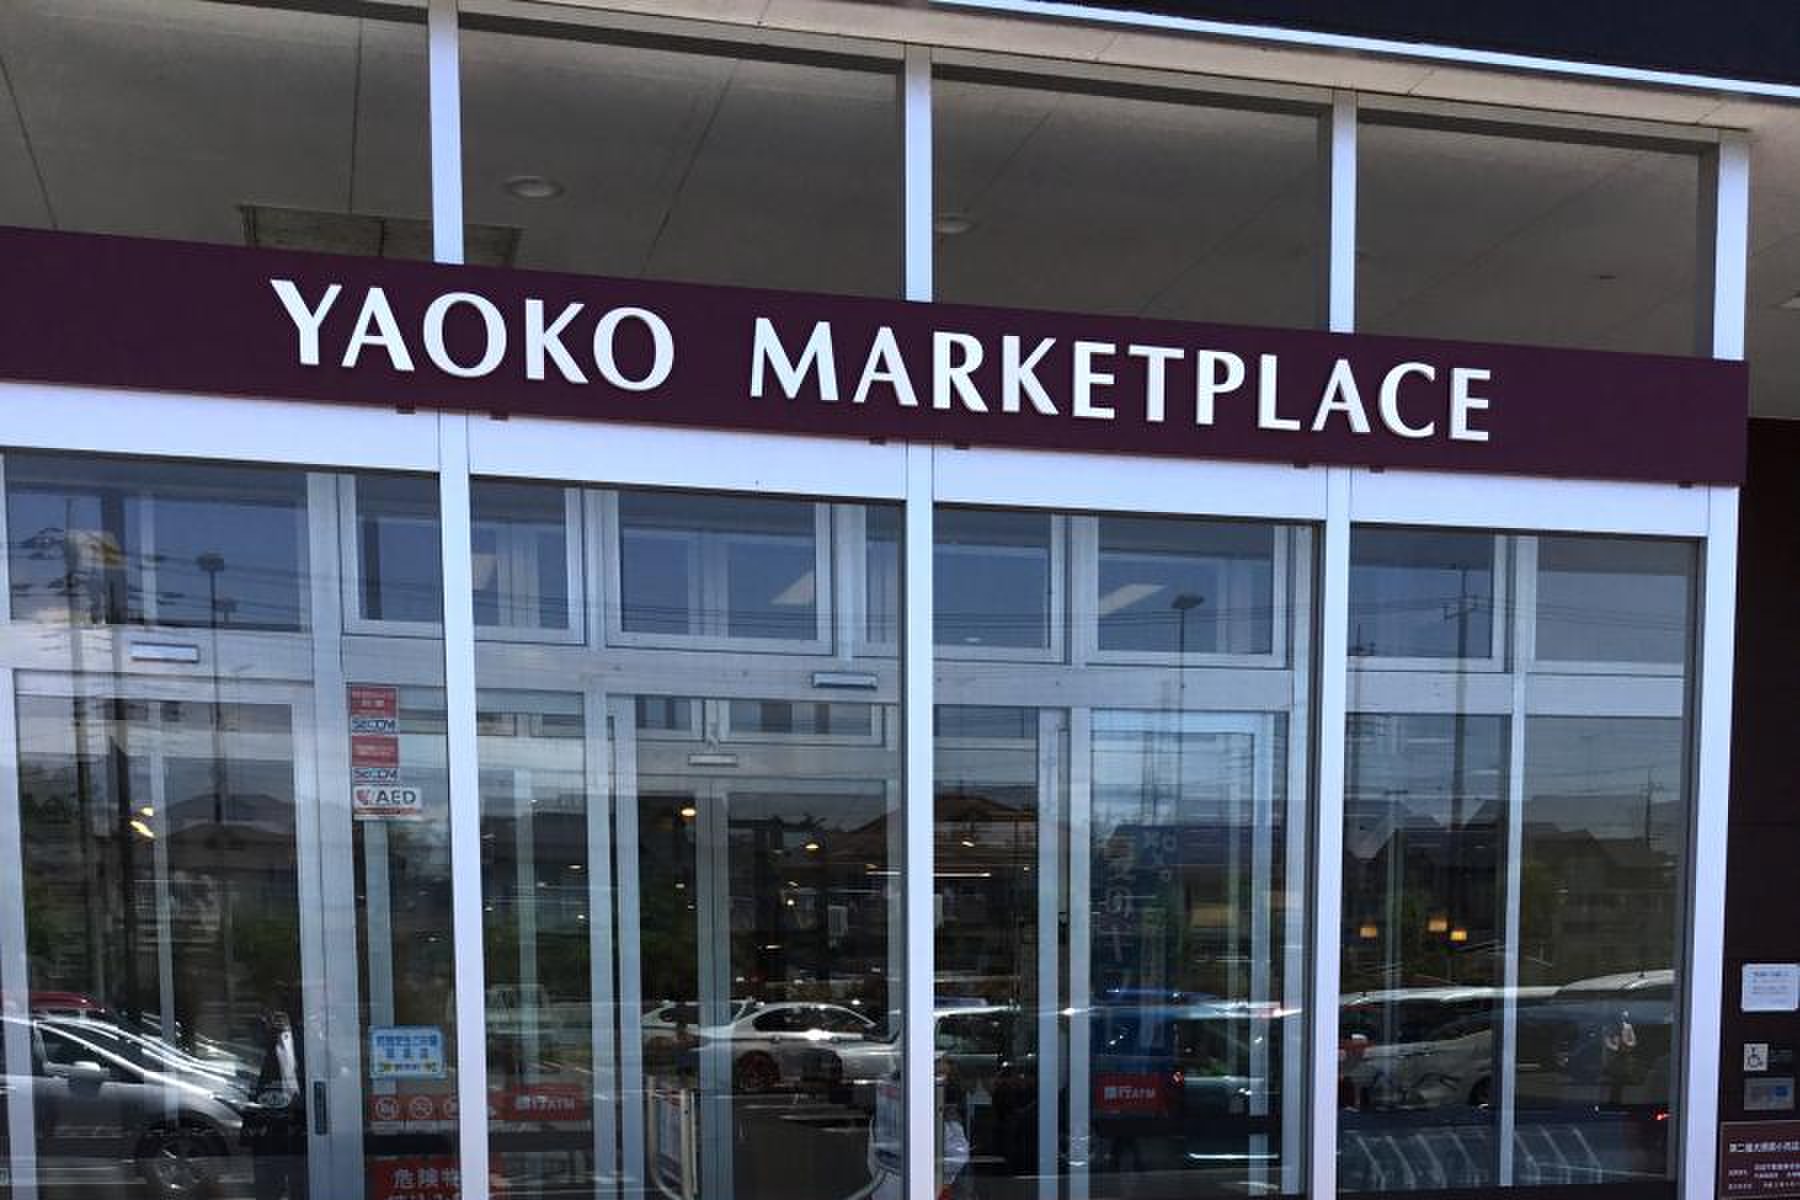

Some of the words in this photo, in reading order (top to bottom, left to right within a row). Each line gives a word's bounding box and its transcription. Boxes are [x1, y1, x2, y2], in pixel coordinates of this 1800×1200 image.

[269, 277, 676, 391] YAOKO
[749, 316, 1492, 444] MARKETPLACE
[376, 789, 417, 805] AED
